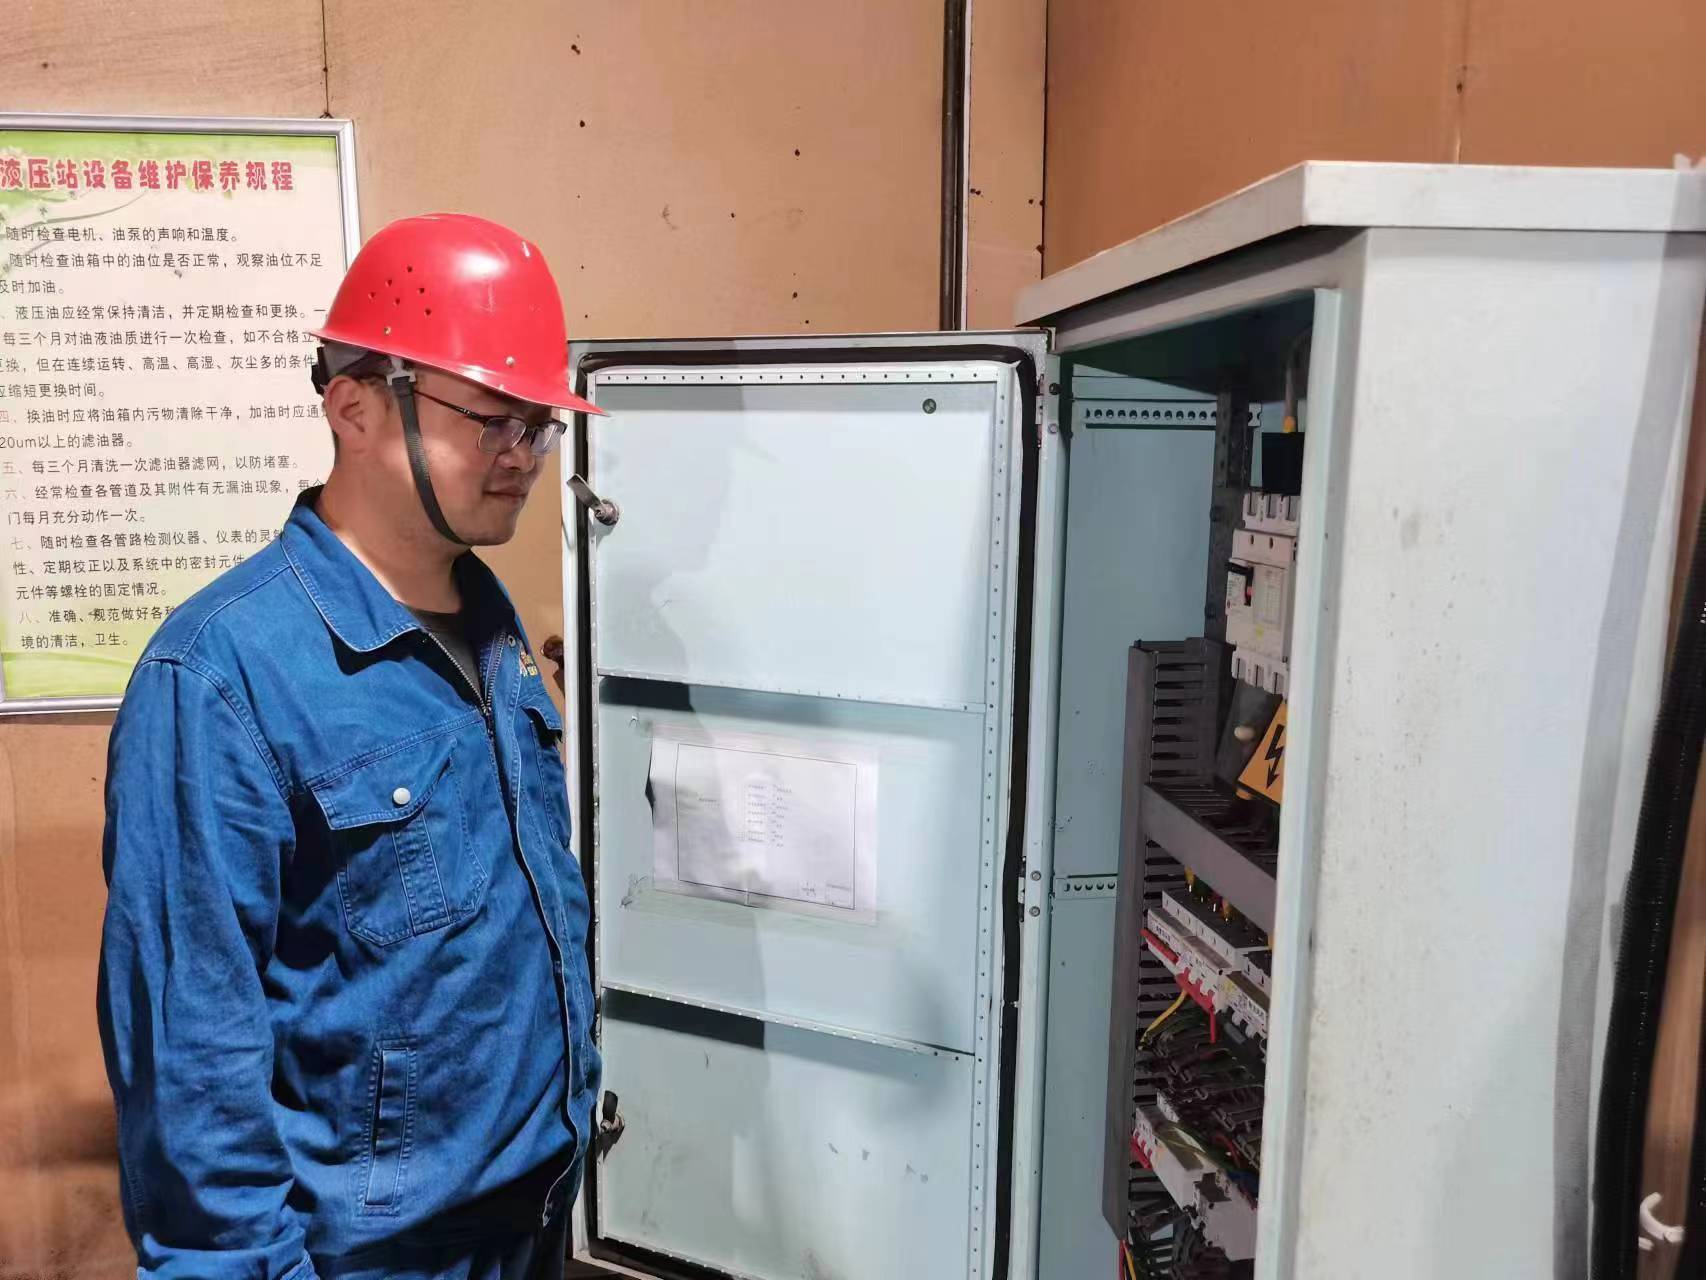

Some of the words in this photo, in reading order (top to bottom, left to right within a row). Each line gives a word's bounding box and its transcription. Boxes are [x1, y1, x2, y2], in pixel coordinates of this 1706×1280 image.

[0, 158, 294, 191] 液压站设备维护保养规程
[6, 226, 239, 242] 随时检查电机、油泵的声响和温度。
[10, 252, 324, 268] 随时检查油箱中的油位是否正常，观察油位不足
[3, 330, 321, 346] 每三个月对油液油质进行一次检查，如不合格立
[0, 355, 318, 373] 换，但在连续运转、高温、高湿、灰尘多的条件
[0, 404, 327, 423] 四、换油时应将油箱内污物清除干净，加油时应通
[8, 509, 146, 525] 门每月充分动作一次。
